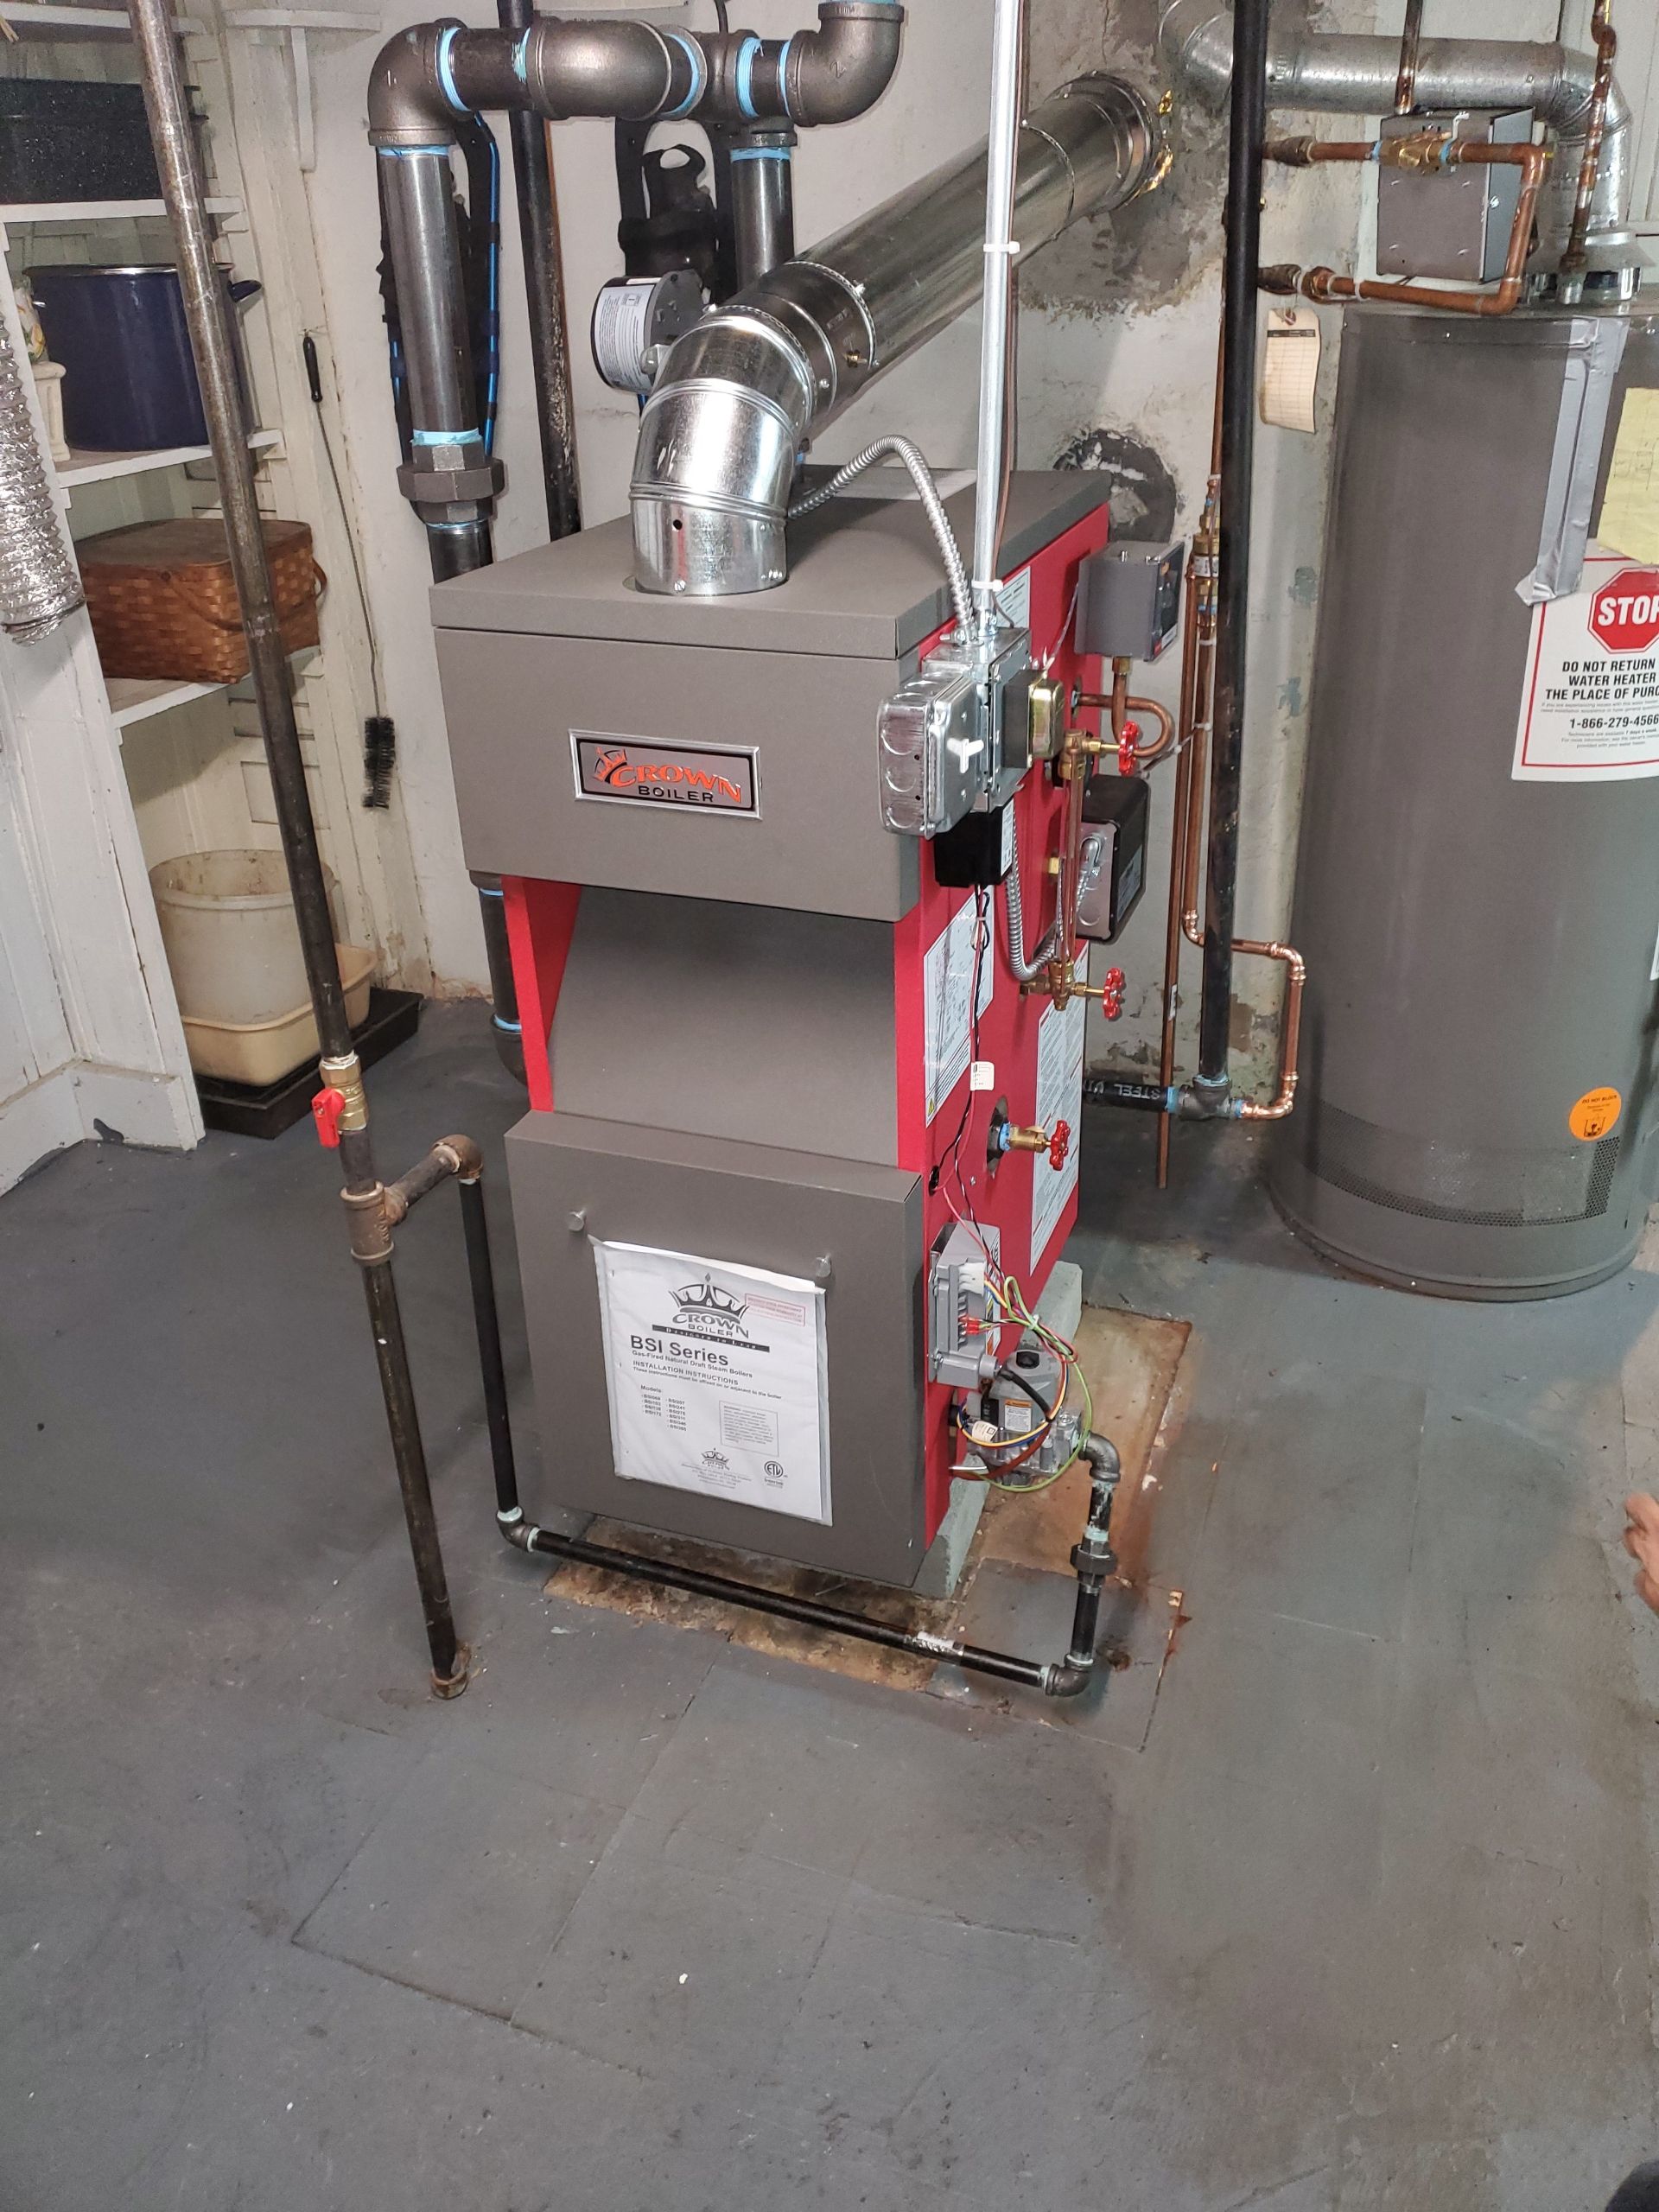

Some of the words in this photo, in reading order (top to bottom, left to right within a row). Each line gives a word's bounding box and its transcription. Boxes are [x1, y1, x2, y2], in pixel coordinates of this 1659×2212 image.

[1562, 661, 1579, 672] DO
[1583, 660, 1607, 672] NOT
[1611, 658, 1656, 672] RETURN
[1568, 674, 1610, 687] WATER
[1613, 672, 1656, 685] HEATER
[1545, 689, 1568, 701] THE
[1573, 688, 1611, 700] PLACE
[1614, 688, 1630, 699] OF
[1569, 714, 1659, 728] 1-866-279-4566
[610, 764, 741, 804] CROWN
[639, 785, 714, 802] BOILER
[1114, 1084, 1160, 1100] STEEL
[672, 1313, 749, 1339] CROWN
[688, 1325, 734, 1337] BOILER
[631, 1335, 663, 1353] BSI
[670, 1341, 728, 1366] Series
[632, 1350, 664, 1361] Gas-Fired
[665, 1355, 689, 1364] Natural
[690, 1360, 706, 1369] Draft
[708, 1364, 728, 1373] Steam
[729, 1368, 753, 1378] Boilers
[633, 1360, 683, 1374] INSTALLATION
[685, 1370, 739, 1385] INSTRUCTIONS
[767, 1464, 781, 1476] ETL
